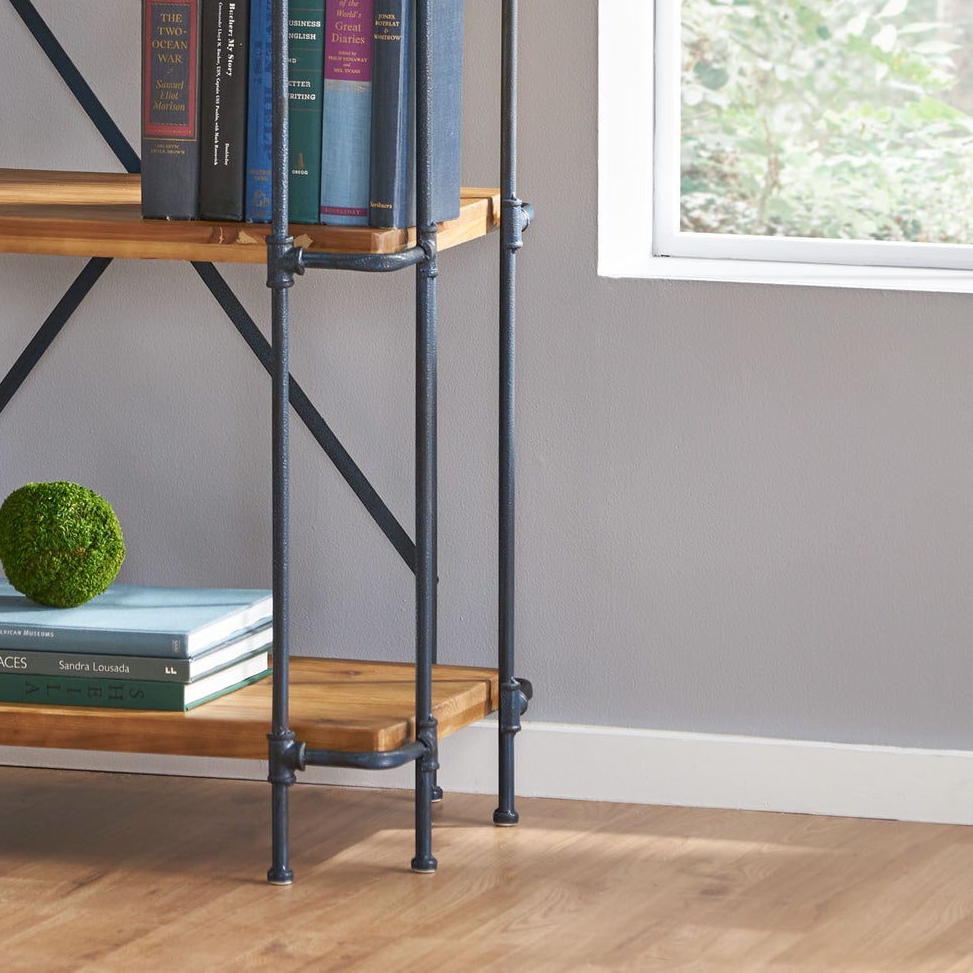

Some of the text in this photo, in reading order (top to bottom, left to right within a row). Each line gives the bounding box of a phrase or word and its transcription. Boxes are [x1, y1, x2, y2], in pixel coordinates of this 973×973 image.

[161, 13, 183, 23] THE
[336, 10, 362, 19] World's
[159, 27, 187, 36] TWO-
[335, 21, 361, 32] Great
[331, 33, 365, 44] Diaries
[152, 41, 187, 49] OCEAN
[227, 39, 234, 51] My
[158, 55, 182, 63] WAR
[226, 54, 234, 76] Story
[156, 79, 184, 89] Samuel
[160, 91, 179, 100] Eliot
[153, 101, 185, 111] Morison
[59, 660, 130, 673] Sandra Lousada
[165, 666, 177, 674] LL
